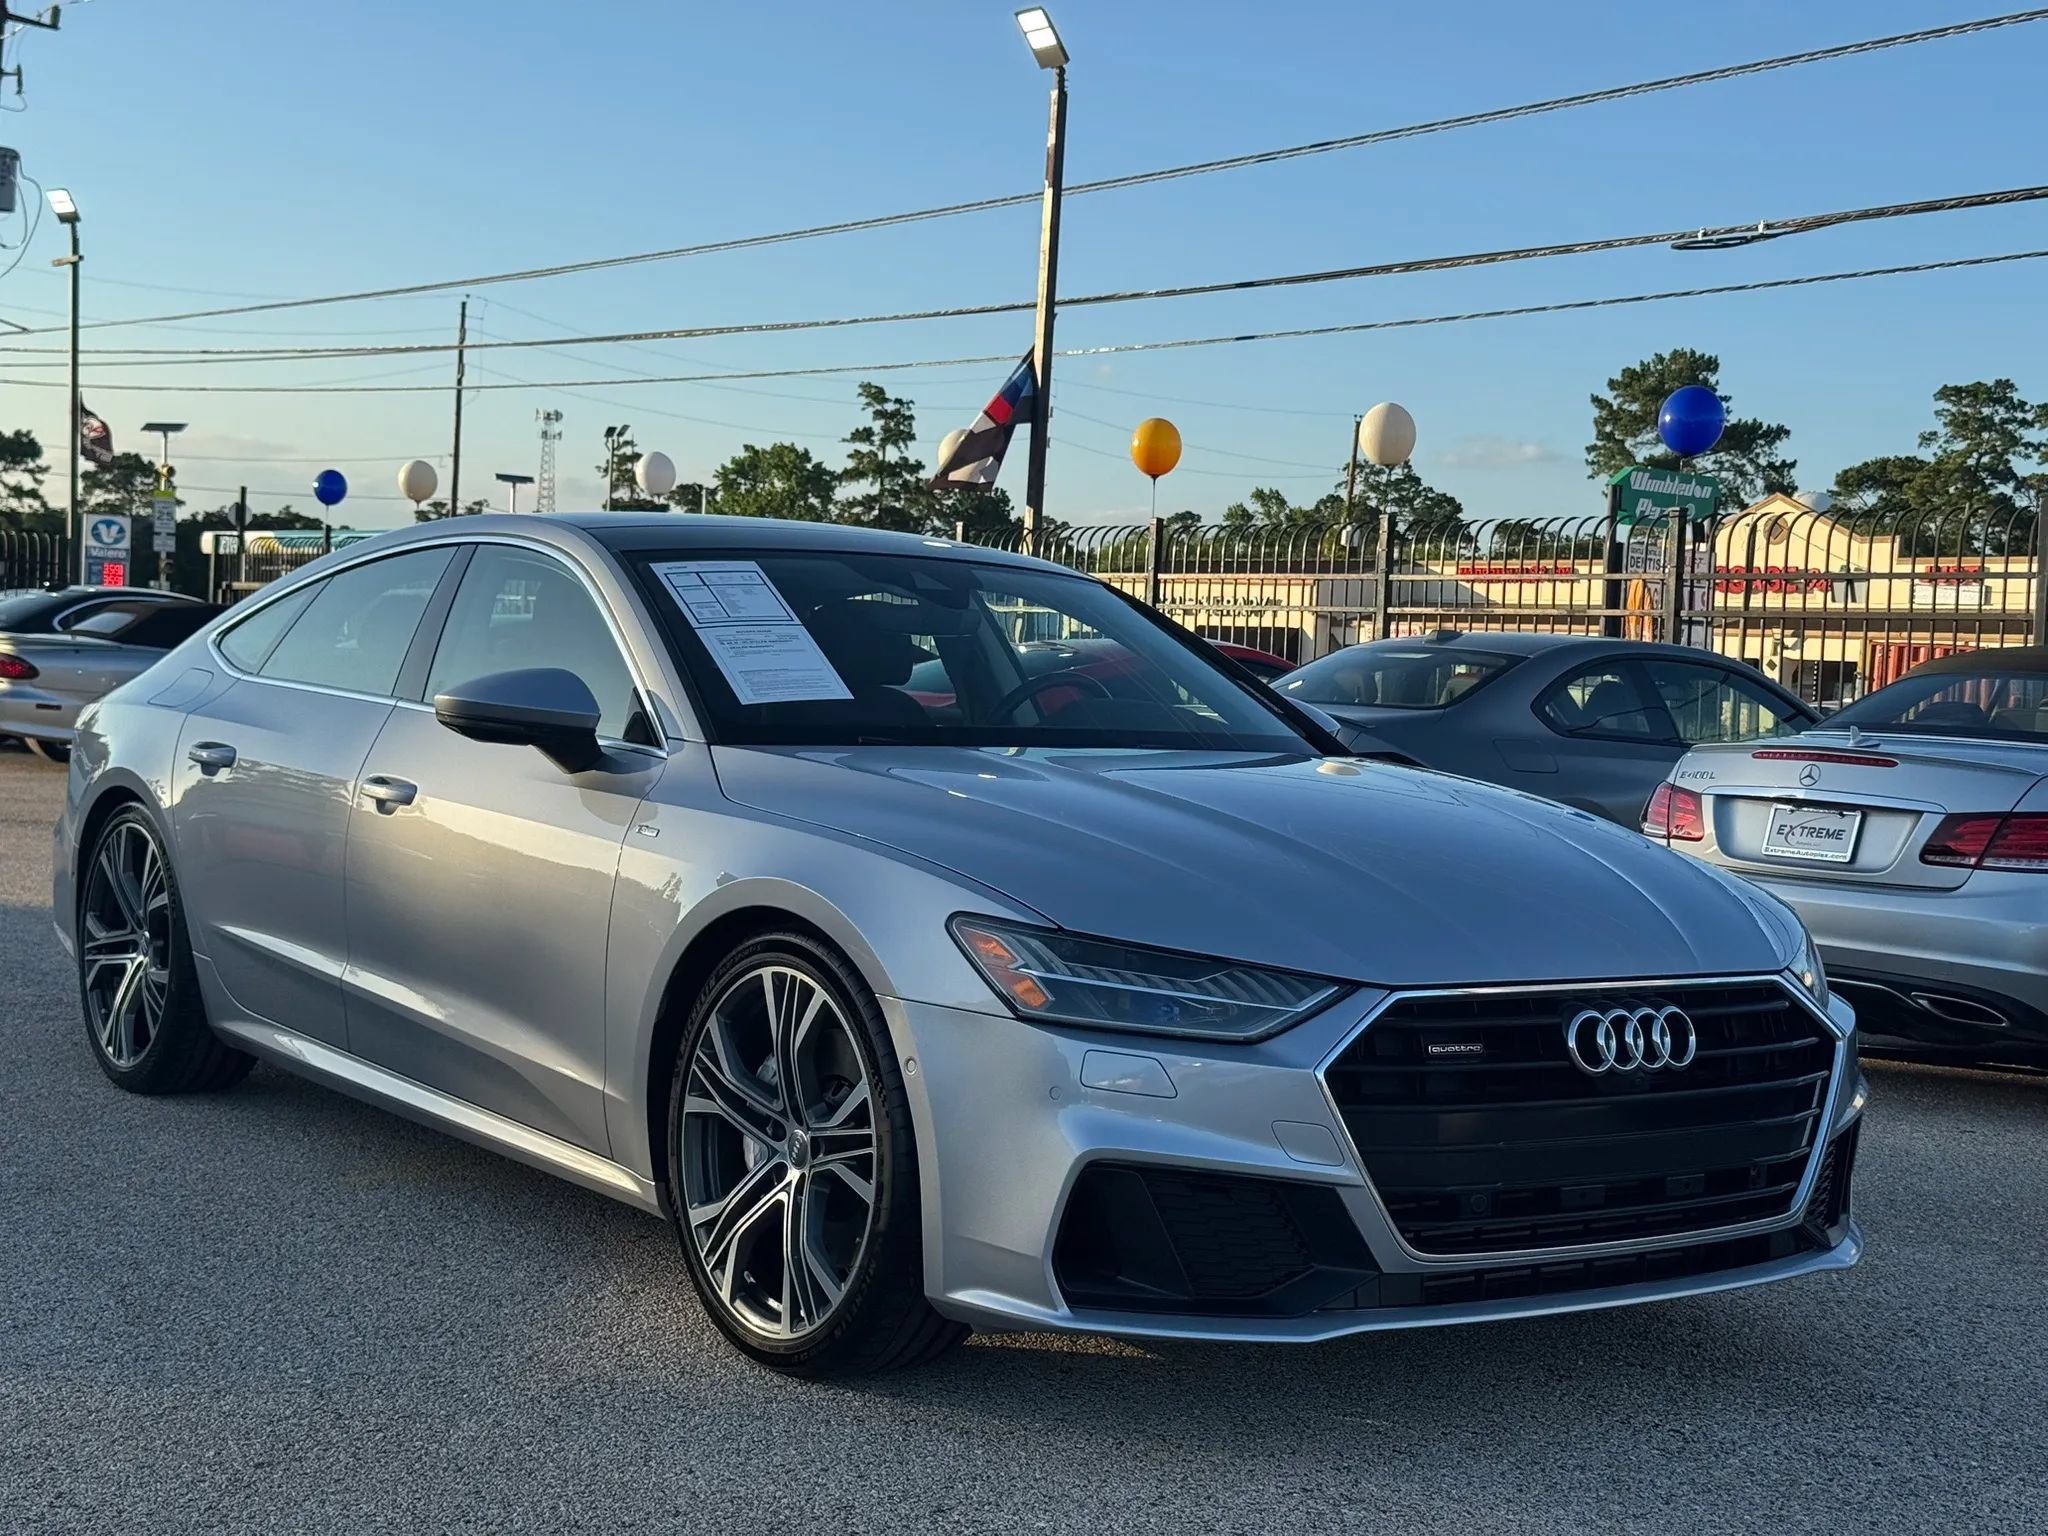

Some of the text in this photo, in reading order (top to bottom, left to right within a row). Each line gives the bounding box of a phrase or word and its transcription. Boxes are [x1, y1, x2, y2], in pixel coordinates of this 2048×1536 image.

[1629, 471, 1713, 499] Wimbledon
[90, 548, 127, 559] Valero
[1776, 824, 1847, 841] EXTREME
[1431, 1044, 1481, 1053] quattro
